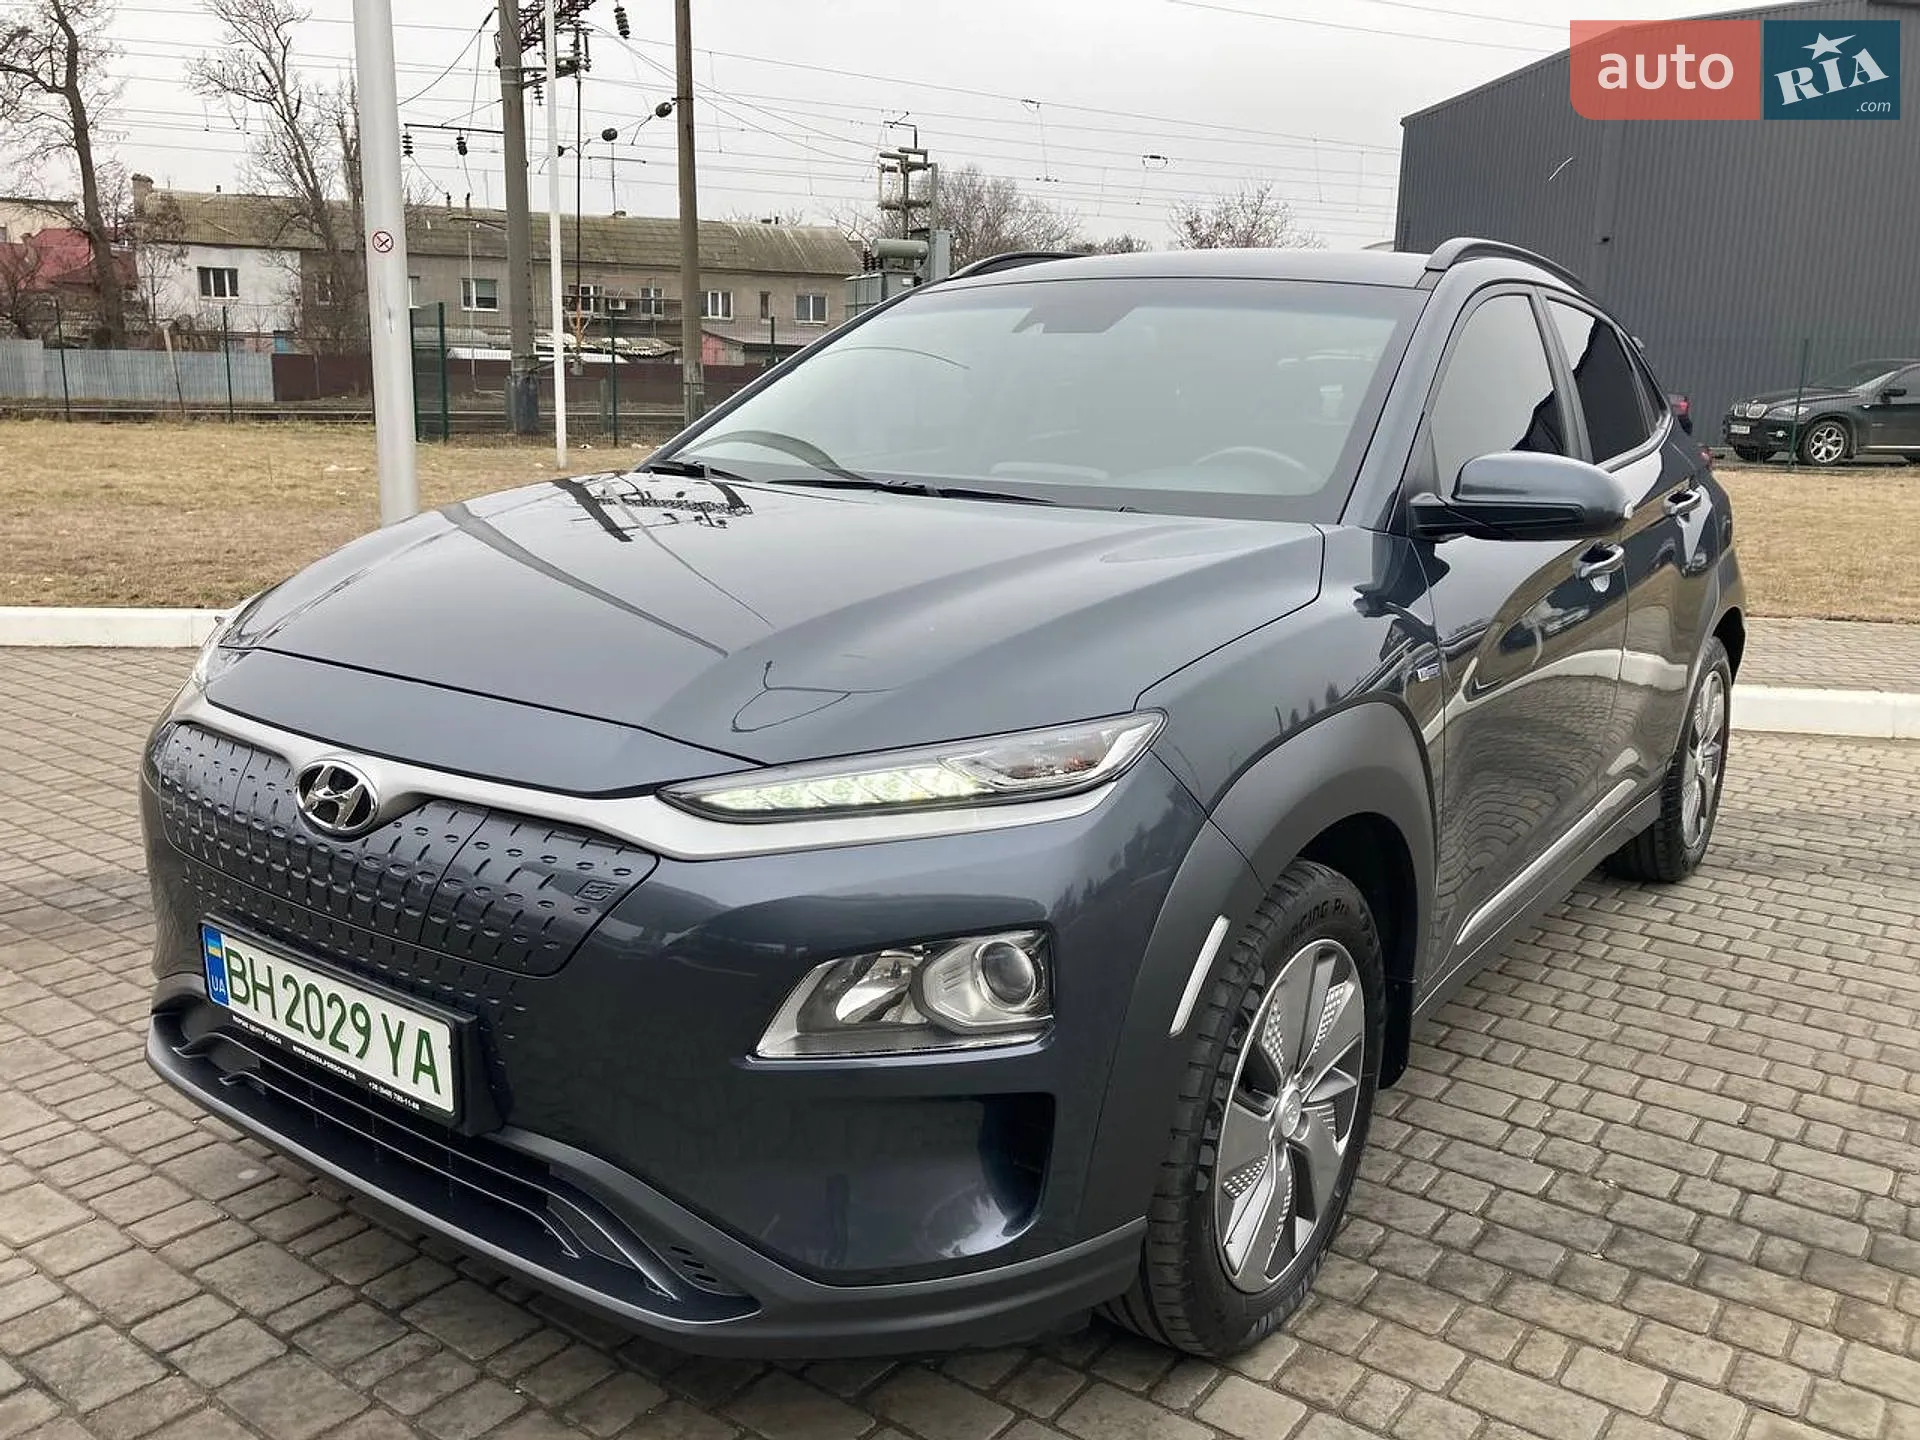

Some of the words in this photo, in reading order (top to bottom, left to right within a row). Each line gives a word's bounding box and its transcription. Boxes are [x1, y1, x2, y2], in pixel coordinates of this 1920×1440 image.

[211, 975, 226, 996] UA
[225, 946, 277, 1020] BH
[282, 973, 372, 1060] 2029
[381, 1012, 441, 1095] YA
